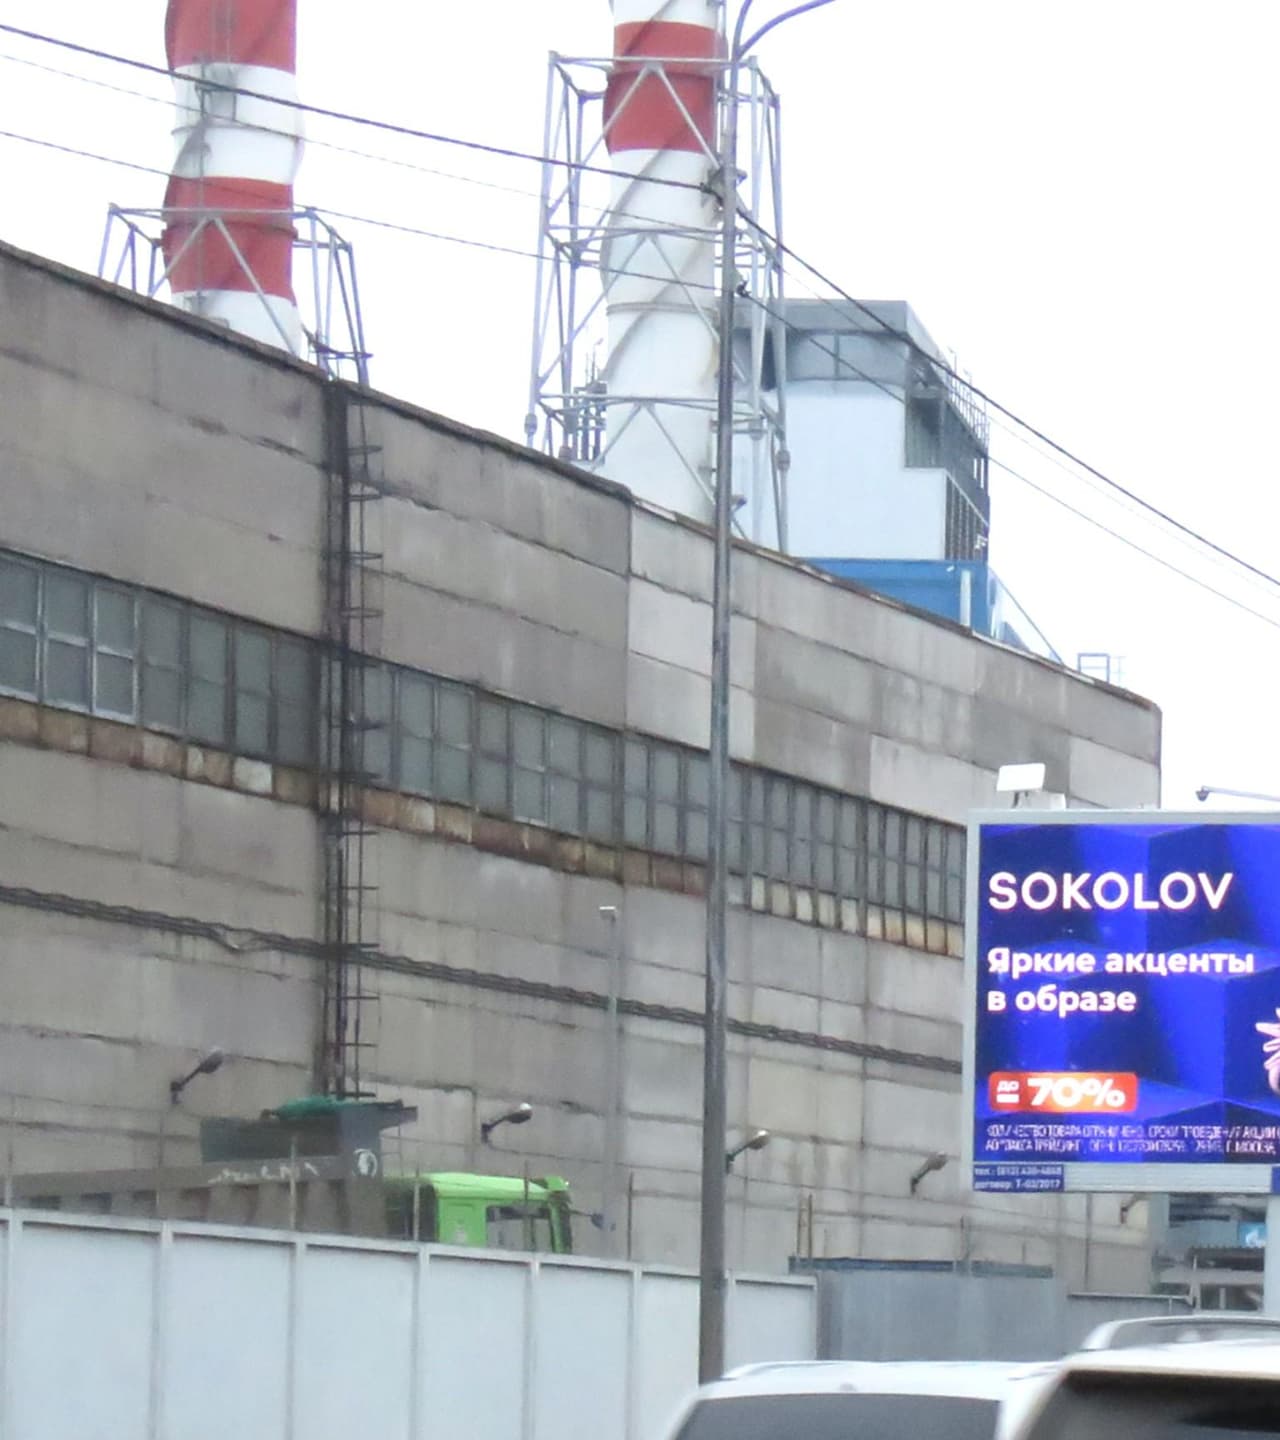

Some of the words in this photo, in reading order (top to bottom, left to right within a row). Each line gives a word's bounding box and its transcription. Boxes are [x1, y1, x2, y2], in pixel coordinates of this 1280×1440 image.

[988, 871, 1234, 911] SOKOLOV
[987, 946, 1096, 980] Яркие
[1104, 952, 1255, 977] акценты
[987, 990, 1006, 1011] в
[1015, 983, 1137, 1019] образе
